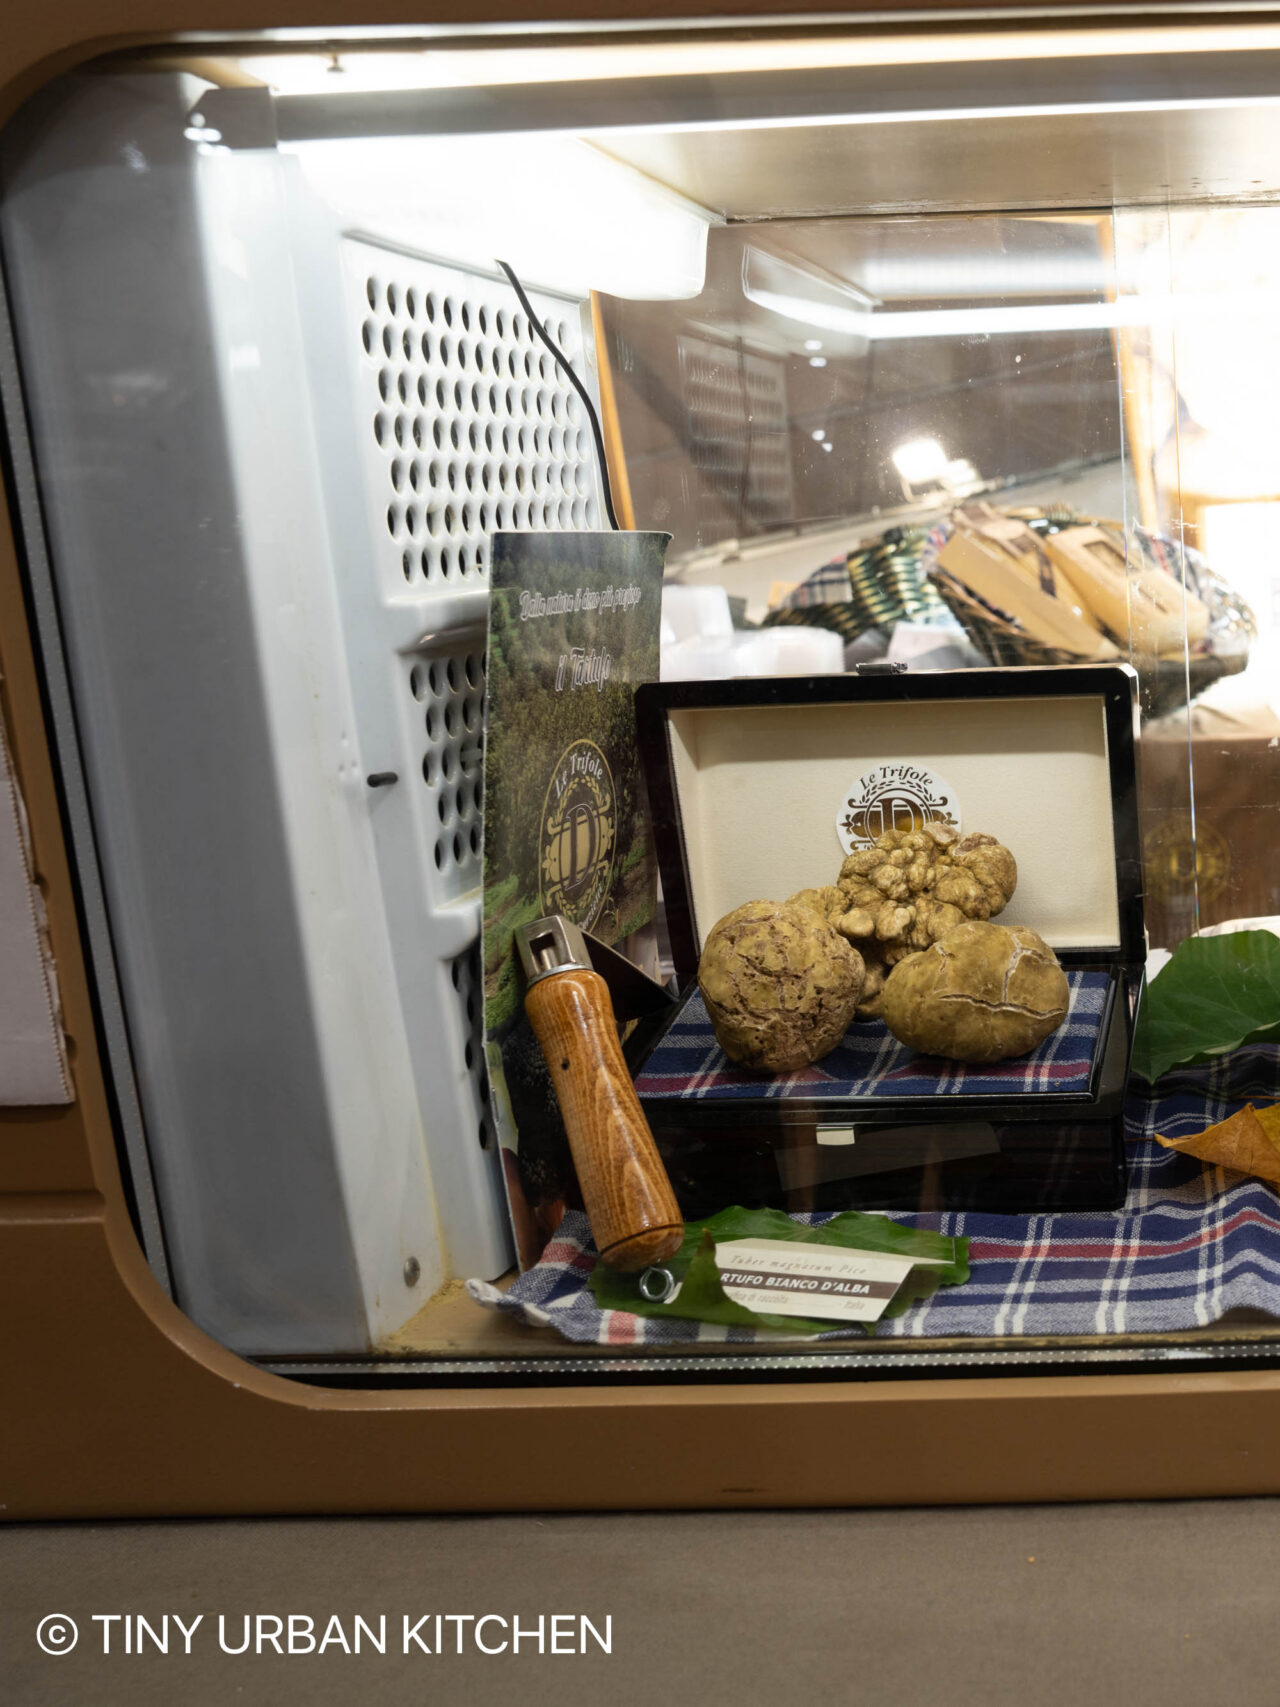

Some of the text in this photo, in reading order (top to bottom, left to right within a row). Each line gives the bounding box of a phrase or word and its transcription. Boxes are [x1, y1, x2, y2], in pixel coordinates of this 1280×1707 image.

[570, 646, 611, 692] Tartufo
[555, 751, 603, 800] Le Trifole
[860, 766, 933, 790] Le Trifole
[731, 1255, 867, 1274] Tuber magnatum Pico
[721, 1273, 871, 1295] RTUFO BIANCO D'ALBA
